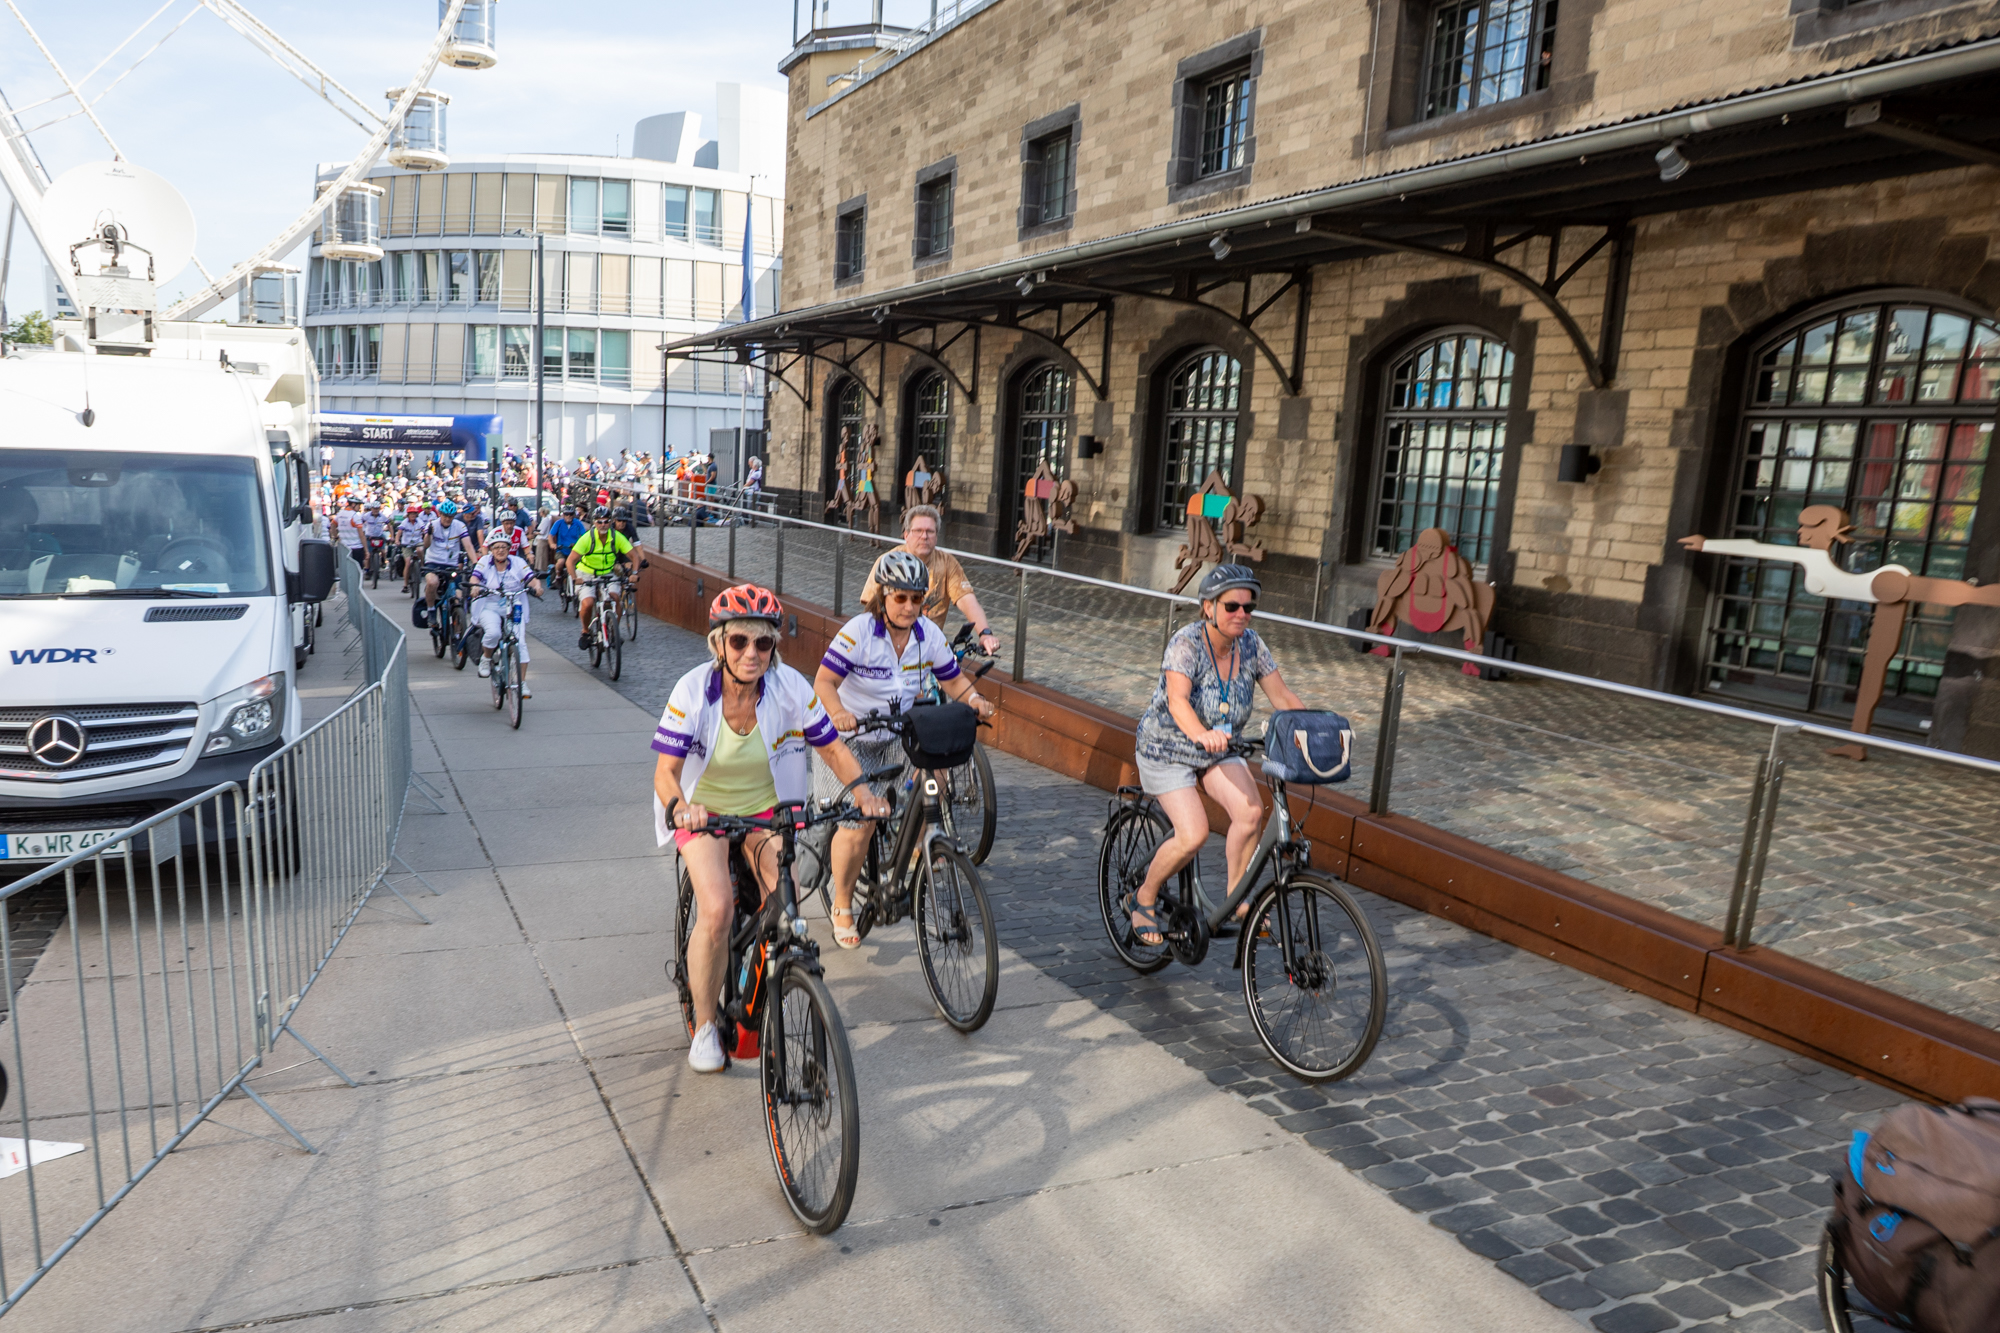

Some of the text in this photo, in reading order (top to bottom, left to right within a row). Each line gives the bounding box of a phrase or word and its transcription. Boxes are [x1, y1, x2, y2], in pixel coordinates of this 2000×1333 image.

[362, 427, 394, 440] START
[9, 648, 98, 665] WDR
[16, 836, 30, 854] K
[45, 834, 74, 853] WR
